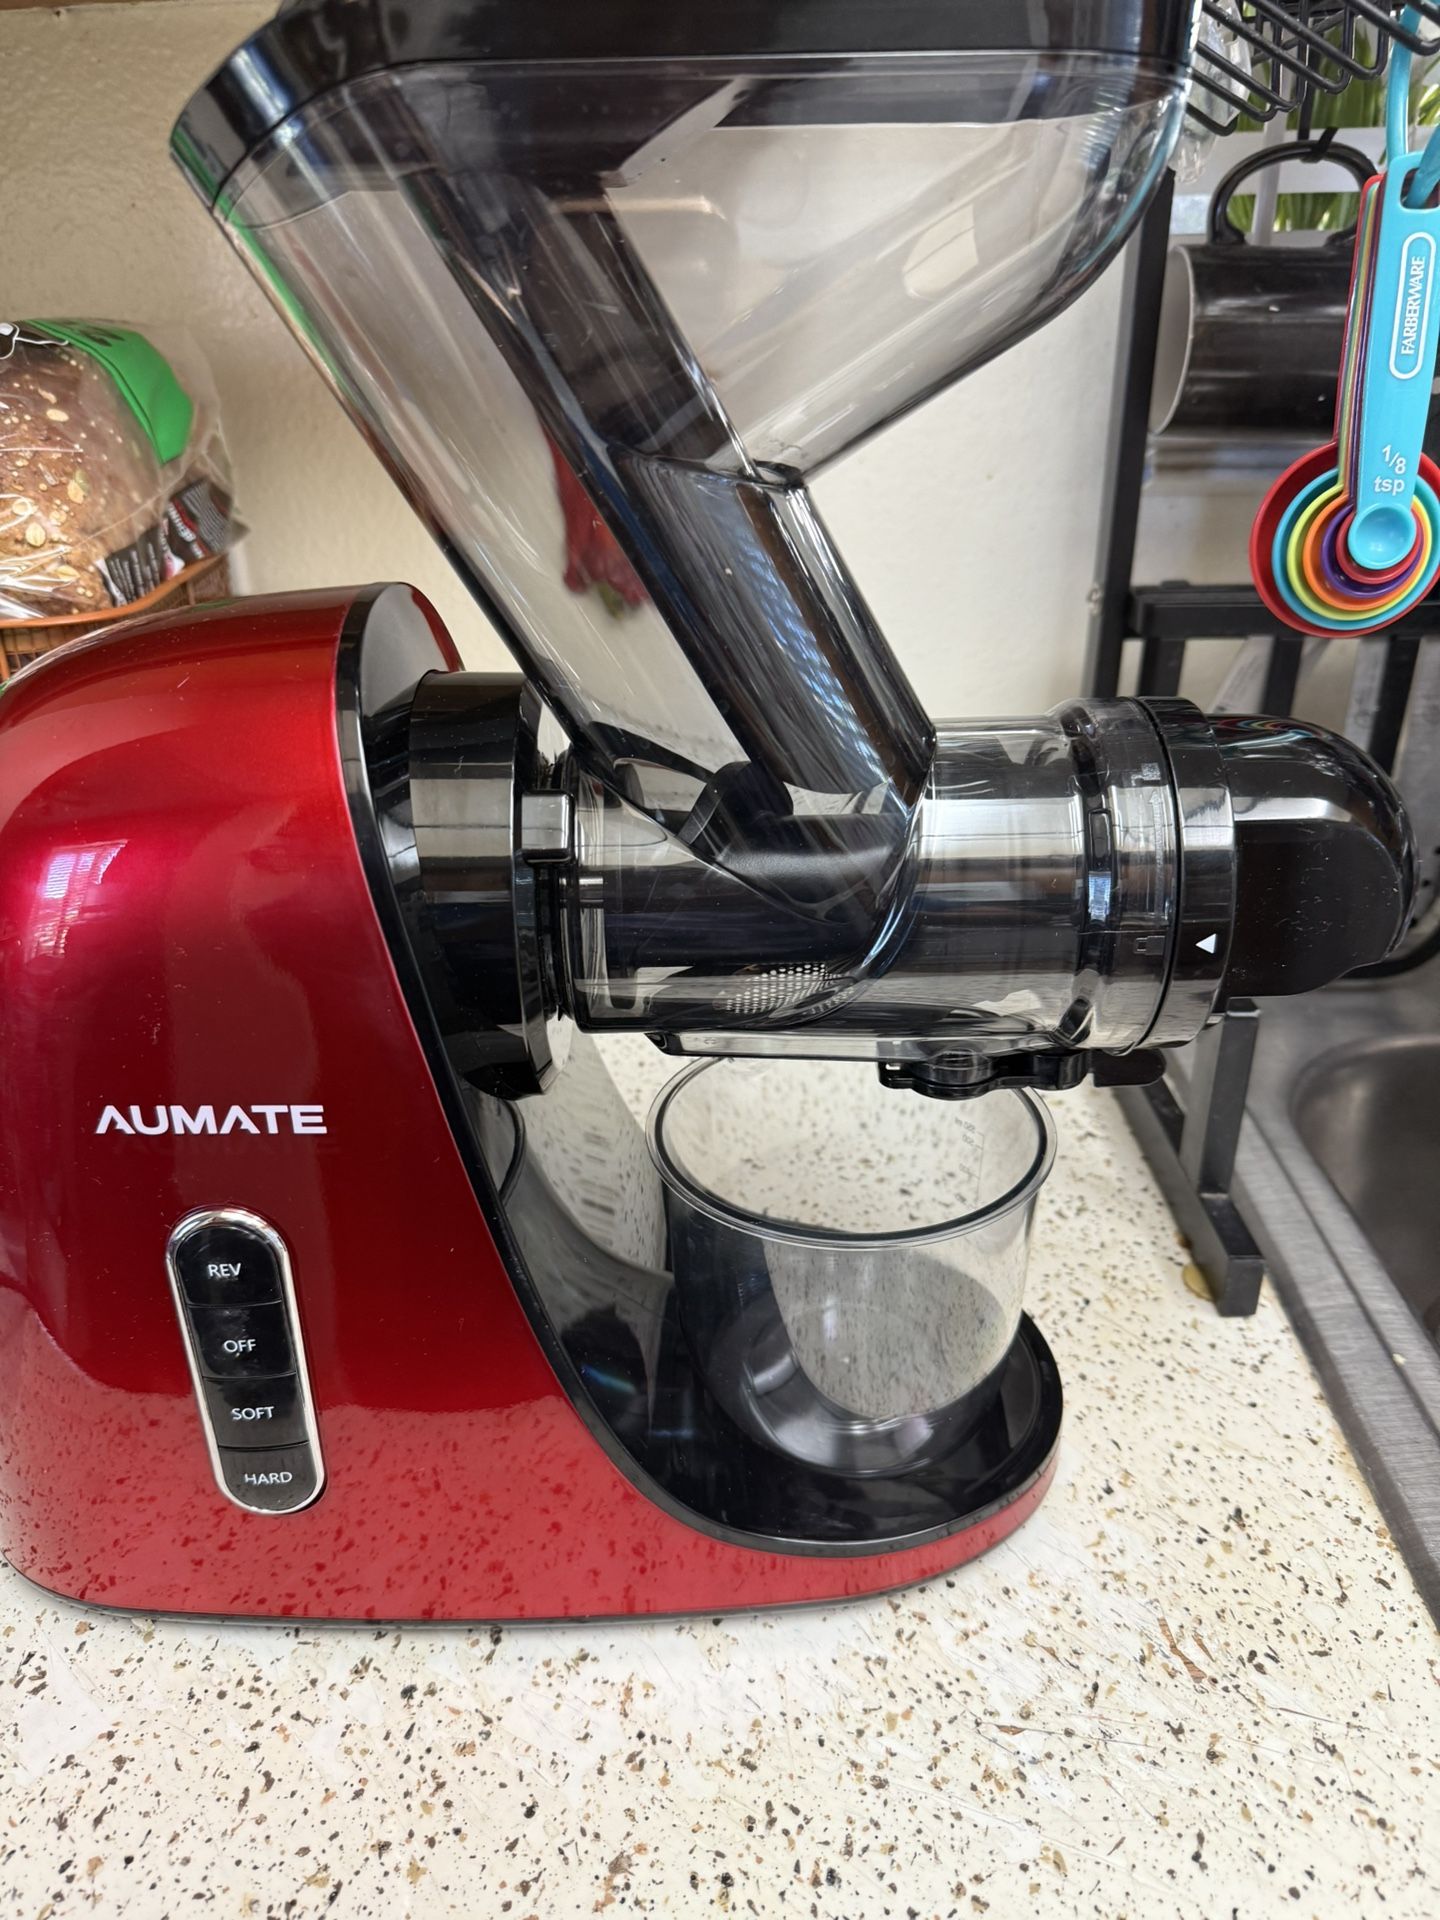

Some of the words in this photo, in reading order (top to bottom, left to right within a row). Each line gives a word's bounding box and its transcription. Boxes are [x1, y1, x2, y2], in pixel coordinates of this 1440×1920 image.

[1400, 255, 1426, 355] FARBERWARE
[1382, 444, 1406, 474] 1/8
[1374, 475, 1405, 496] tsp
[95, 1104, 328, 1135] AUMATE
[207, 1263, 242, 1278] REV
[223, 1339, 257, 1353] OFF
[231, 1406, 275, 1420] SOFT
[244, 1471, 293, 1486] HARD
